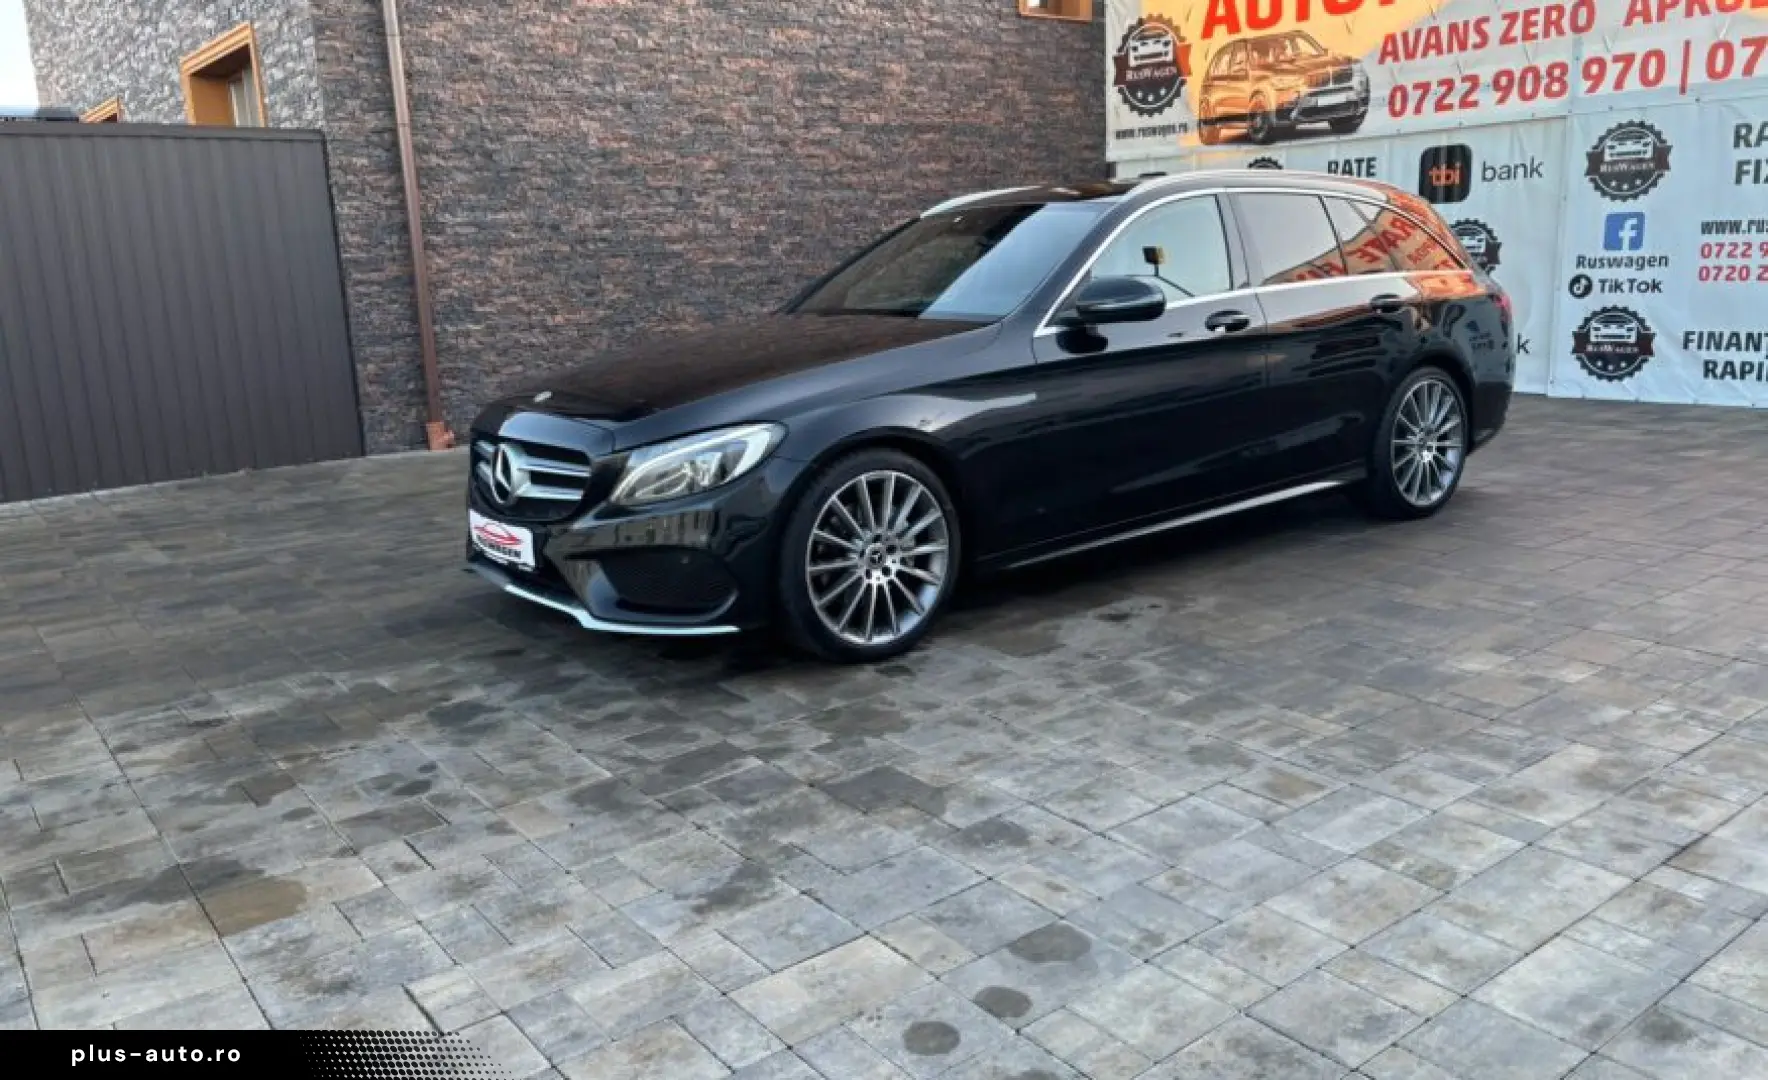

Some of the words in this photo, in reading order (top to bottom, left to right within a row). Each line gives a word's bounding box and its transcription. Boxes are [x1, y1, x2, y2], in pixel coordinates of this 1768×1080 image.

[1378, 16, 1490, 65] AVANS
[1500, 0, 1596, 45] ZERO
[1623, 0, 1768, 27] APR
[1388, 74, 1480, 118] 0722
[1492, 61, 1569, 105] 908
[1582, 48, 1666, 94] 970
[1706, 36, 1768, 81] 07
[1327, 157, 1377, 177] RATE
[1481, 156, 1544, 183] bank
[1700, 242, 1753, 259] 0722
[1575, 254, 1669, 271] Ruswagen
[1698, 265, 1751, 282] 0720
[1598, 278, 1663, 294] TikTok
[1682, 331, 1768, 360] FINAN
[1703, 359, 1768, 382] RAPI
